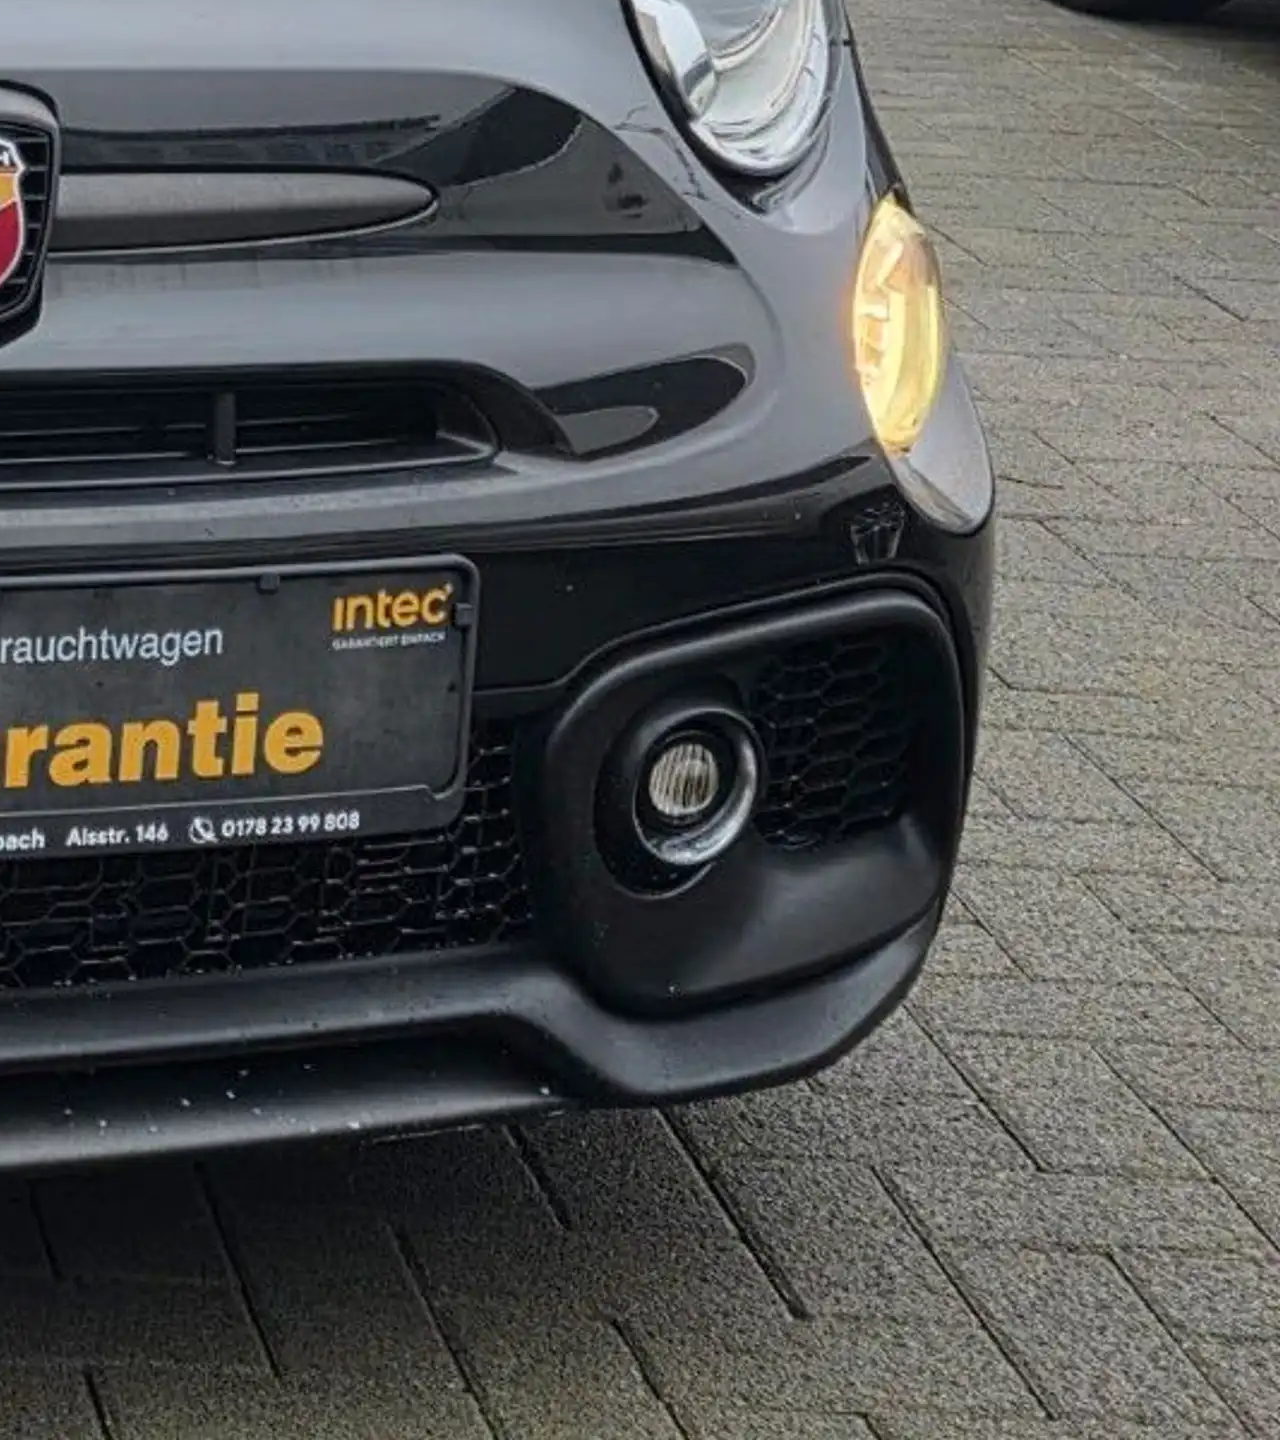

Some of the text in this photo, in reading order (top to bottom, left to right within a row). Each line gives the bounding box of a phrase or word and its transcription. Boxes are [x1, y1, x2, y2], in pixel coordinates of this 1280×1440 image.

[135, 821, 169, 843] 146
[221, 816, 267, 838] 0178
[270, 815, 294, 835] 23
[298, 813, 320, 833] 99
[324, 809, 360, 832] 808
